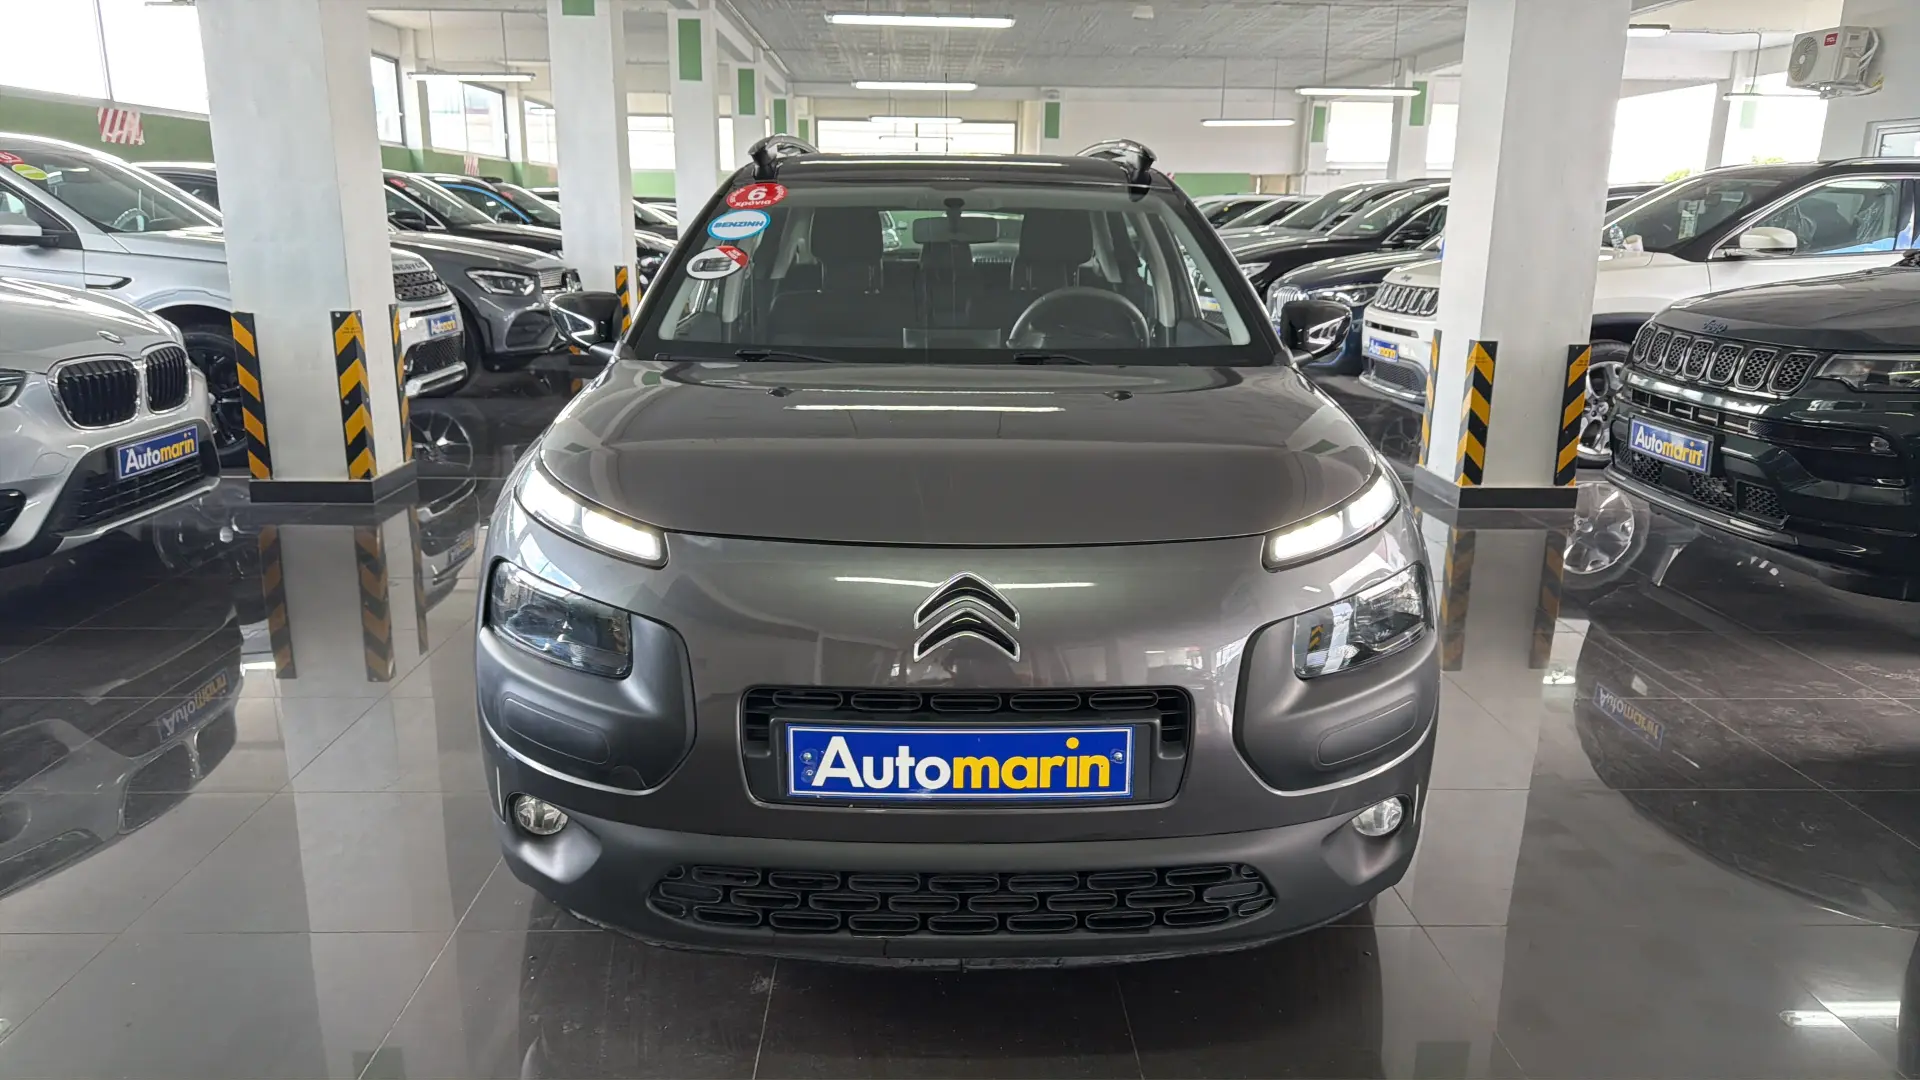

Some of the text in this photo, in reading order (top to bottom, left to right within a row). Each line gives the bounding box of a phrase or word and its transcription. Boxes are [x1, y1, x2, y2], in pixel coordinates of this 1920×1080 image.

[747, 187, 768, 201] 6
[125, 432, 195, 474] Automarin
[1634, 425, 1703, 466] Automarin
[811, 735, 1110, 789] Automarin
